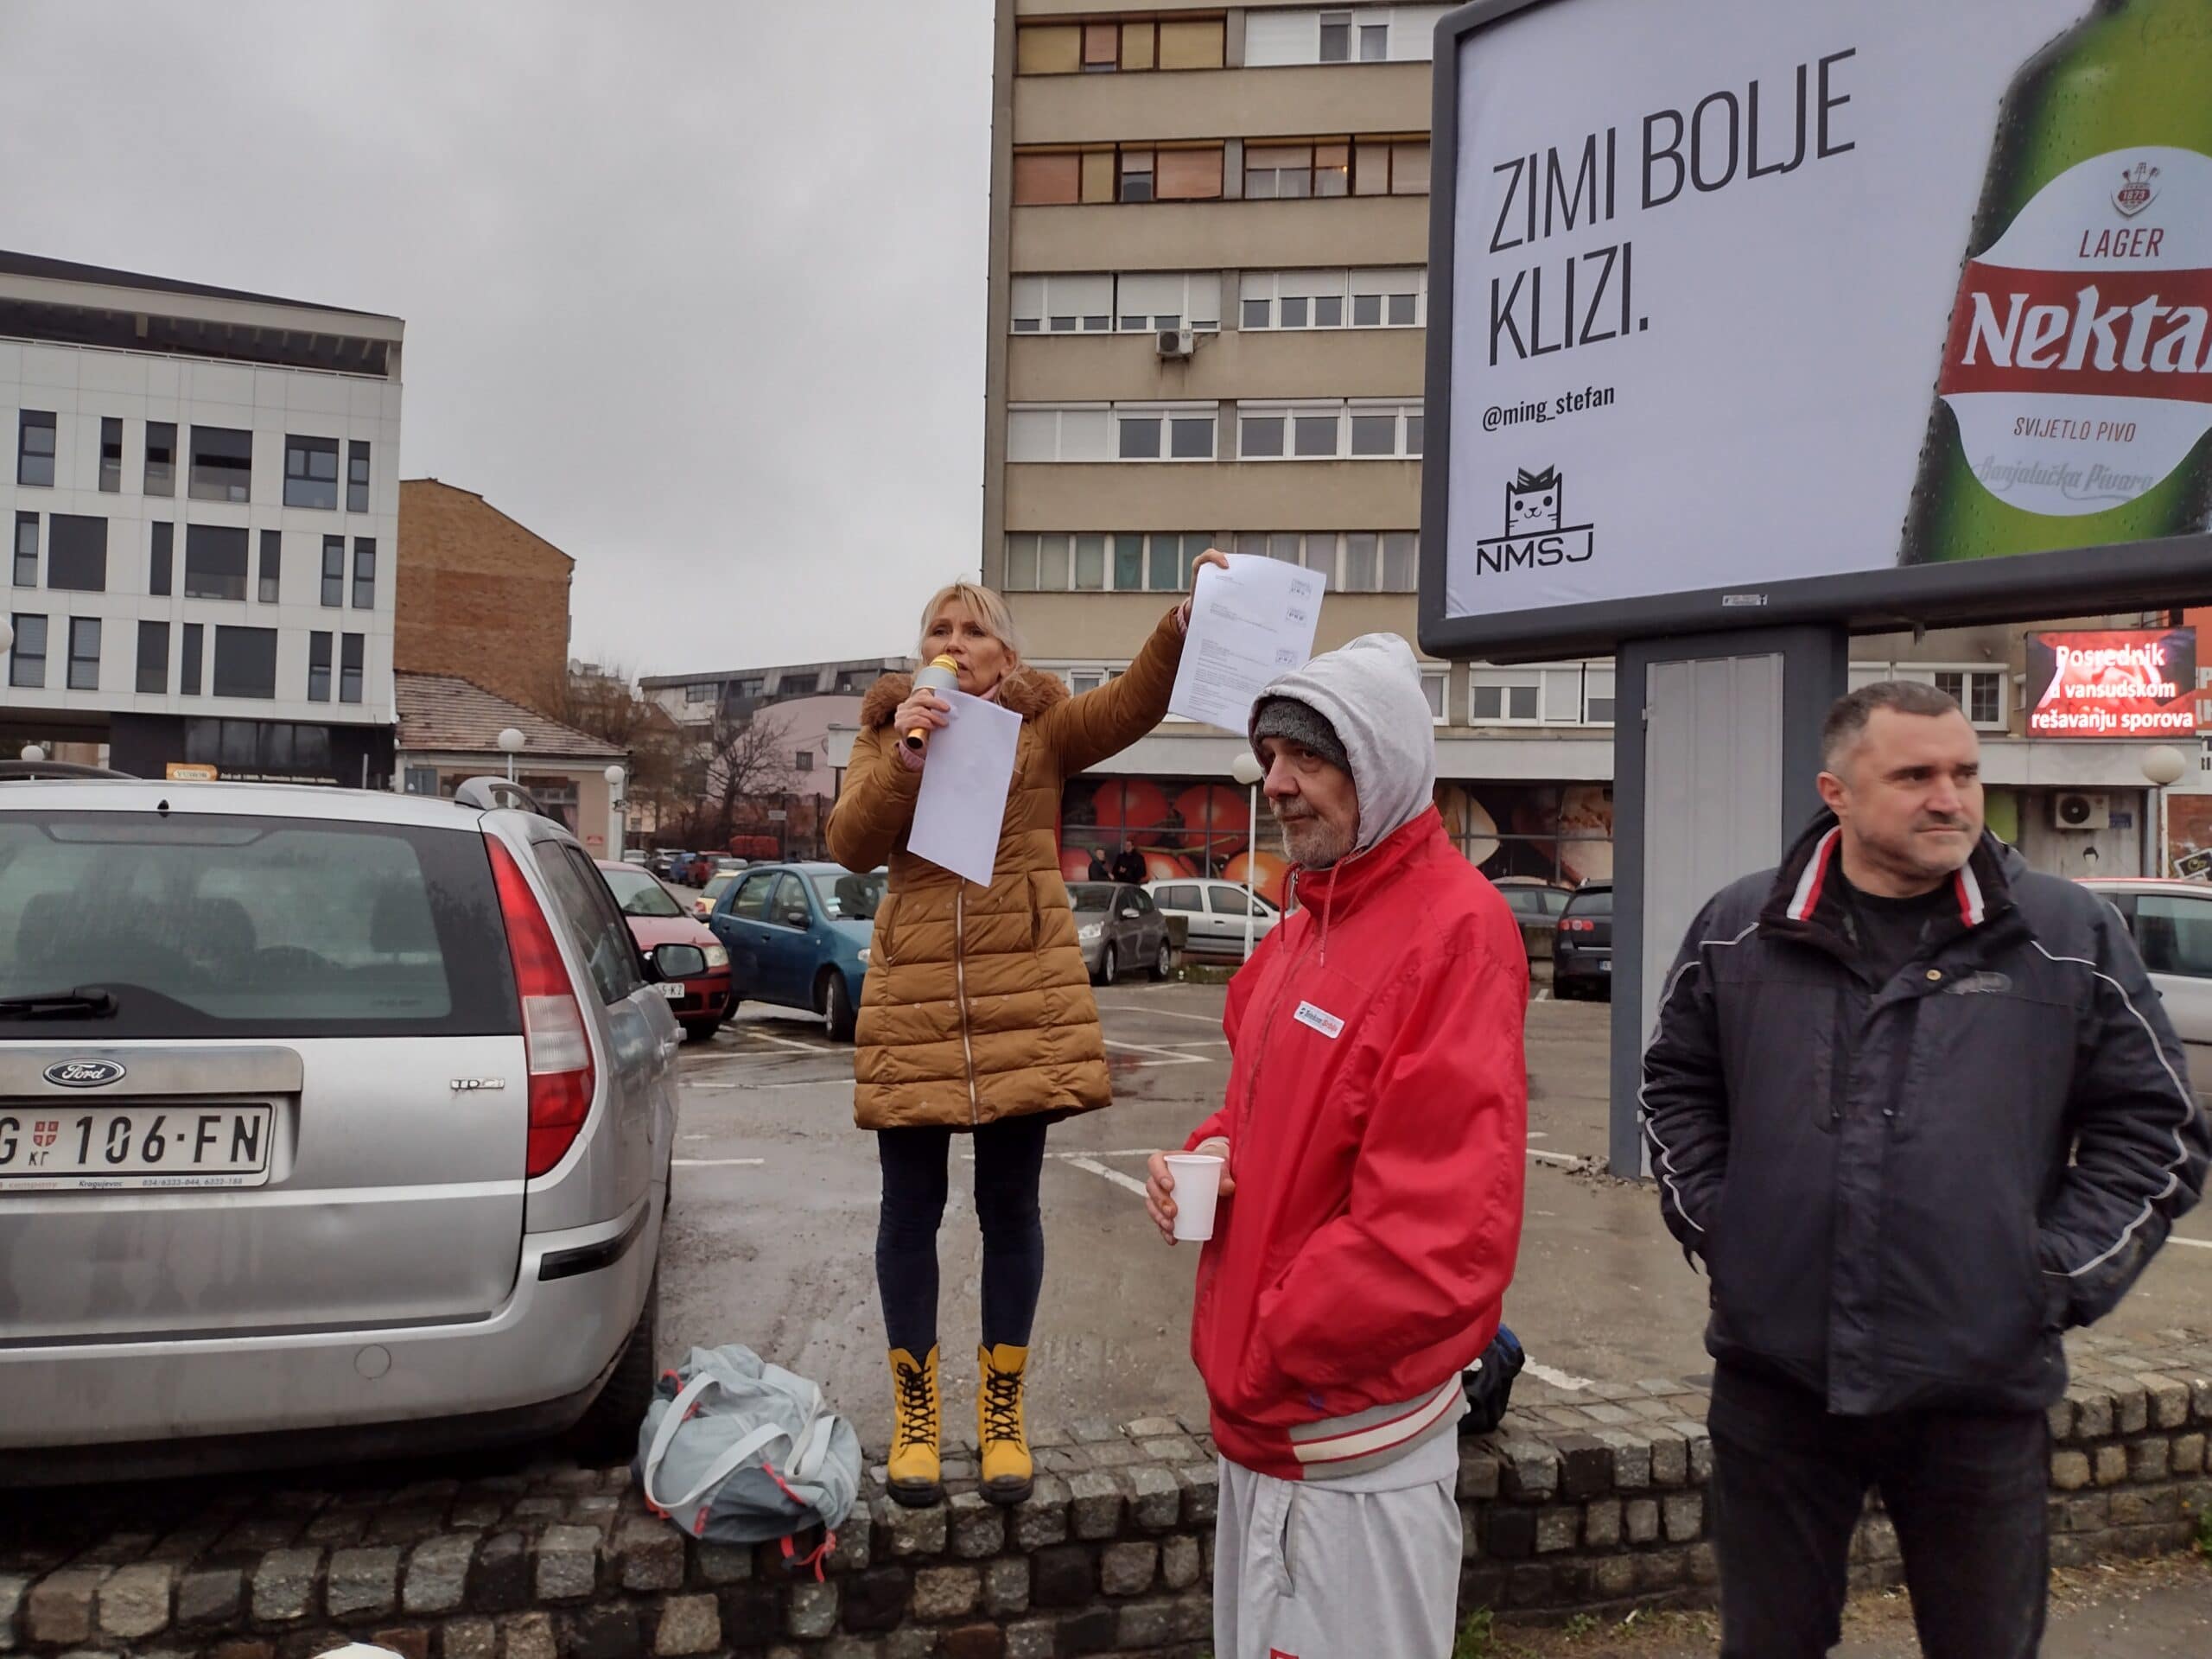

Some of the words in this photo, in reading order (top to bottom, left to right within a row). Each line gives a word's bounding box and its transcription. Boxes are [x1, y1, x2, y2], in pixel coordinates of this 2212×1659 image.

[1490, 127, 1616, 254] ZIMI
[1642, 47, 1856, 210] BOLJE
[2078, 228, 2164, 257] LAGER
[1490, 241, 1649, 366] KLIZI.
[1961, 284, 2212, 373] Nekta
[1483, 385, 1615, 432] @ming_stefan
[2013, 416, 2090, 441] SVIJETLO
[2096, 421, 2137, 442] PIVO
[1476, 531, 1593, 576] NMSJ
[2055, 643, 2165, 668] Posrednik
[2064, 681, 2176, 699] vansudskom
[2031, 709, 2117, 732] rešavanju
[2120, 711, 2194, 732] sporova
[61, 1064, 105, 1079] Ford
